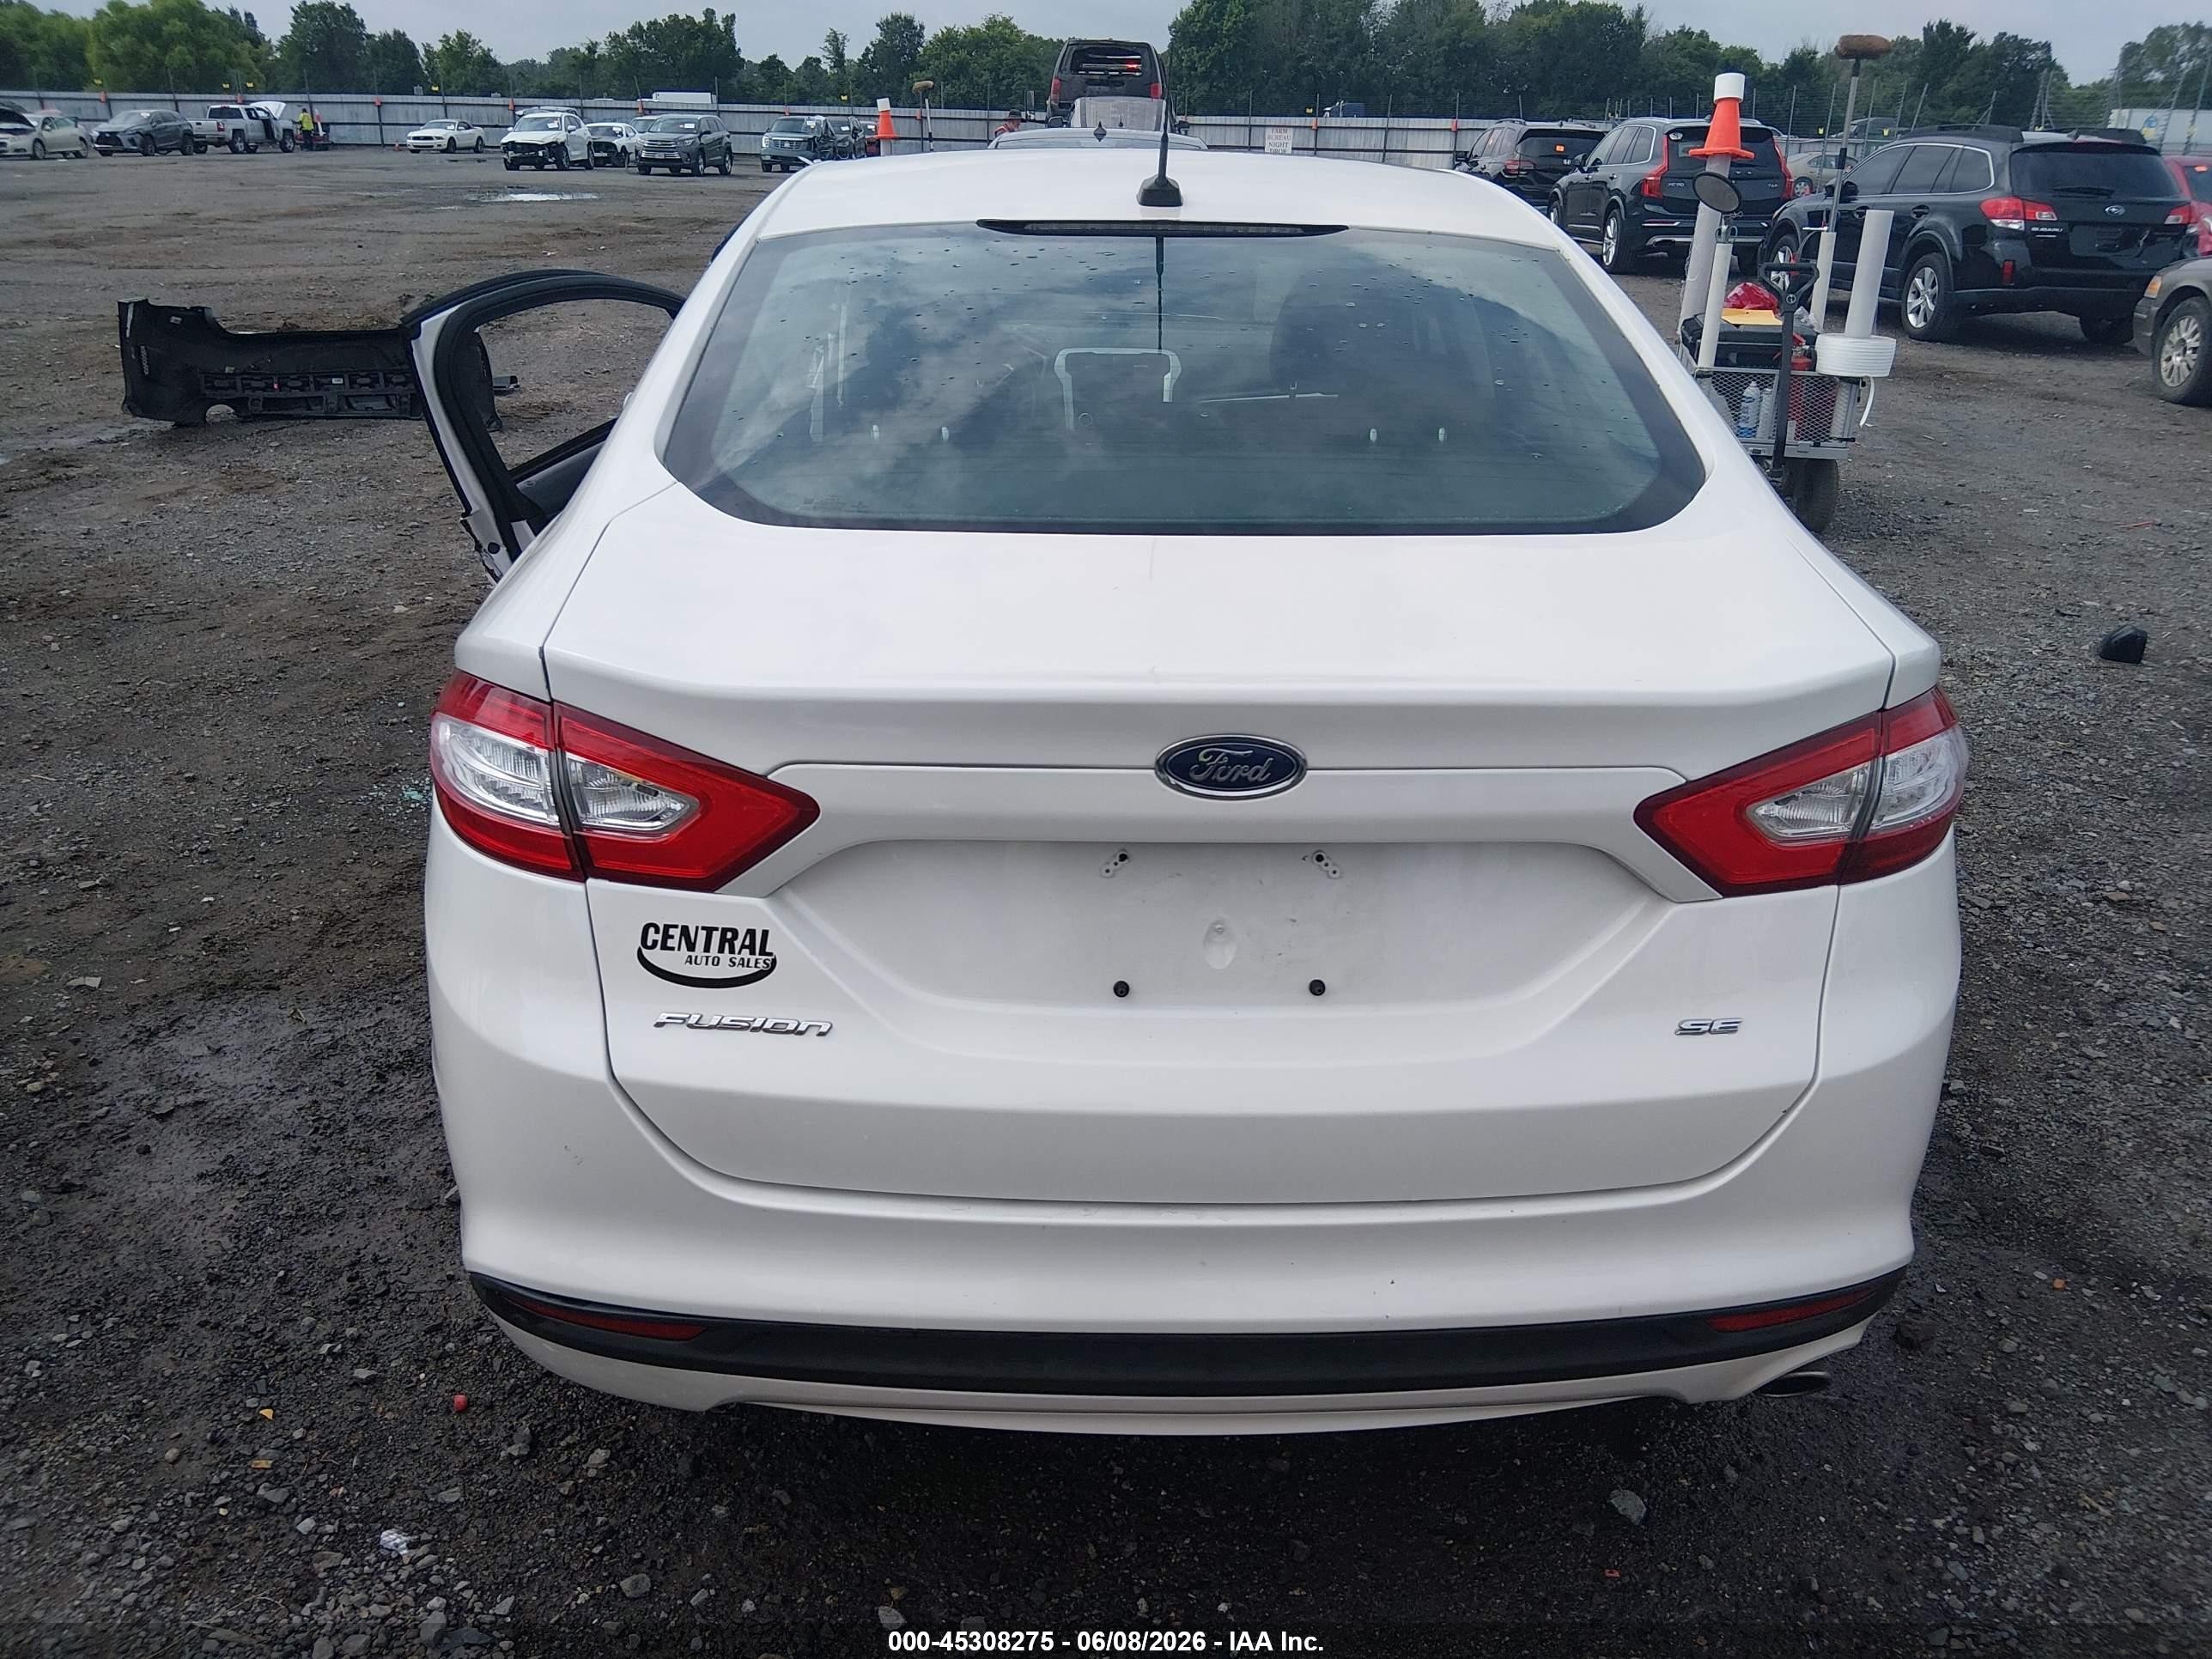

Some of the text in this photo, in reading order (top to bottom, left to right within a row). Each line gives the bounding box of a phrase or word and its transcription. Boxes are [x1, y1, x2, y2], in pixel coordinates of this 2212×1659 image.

[1189, 747, 1274, 783] Ford
[640, 921, 775, 957] CENTRAL
[684, 954, 772, 970] AUTO SALES
[1674, 1017, 1744, 1036] SE
